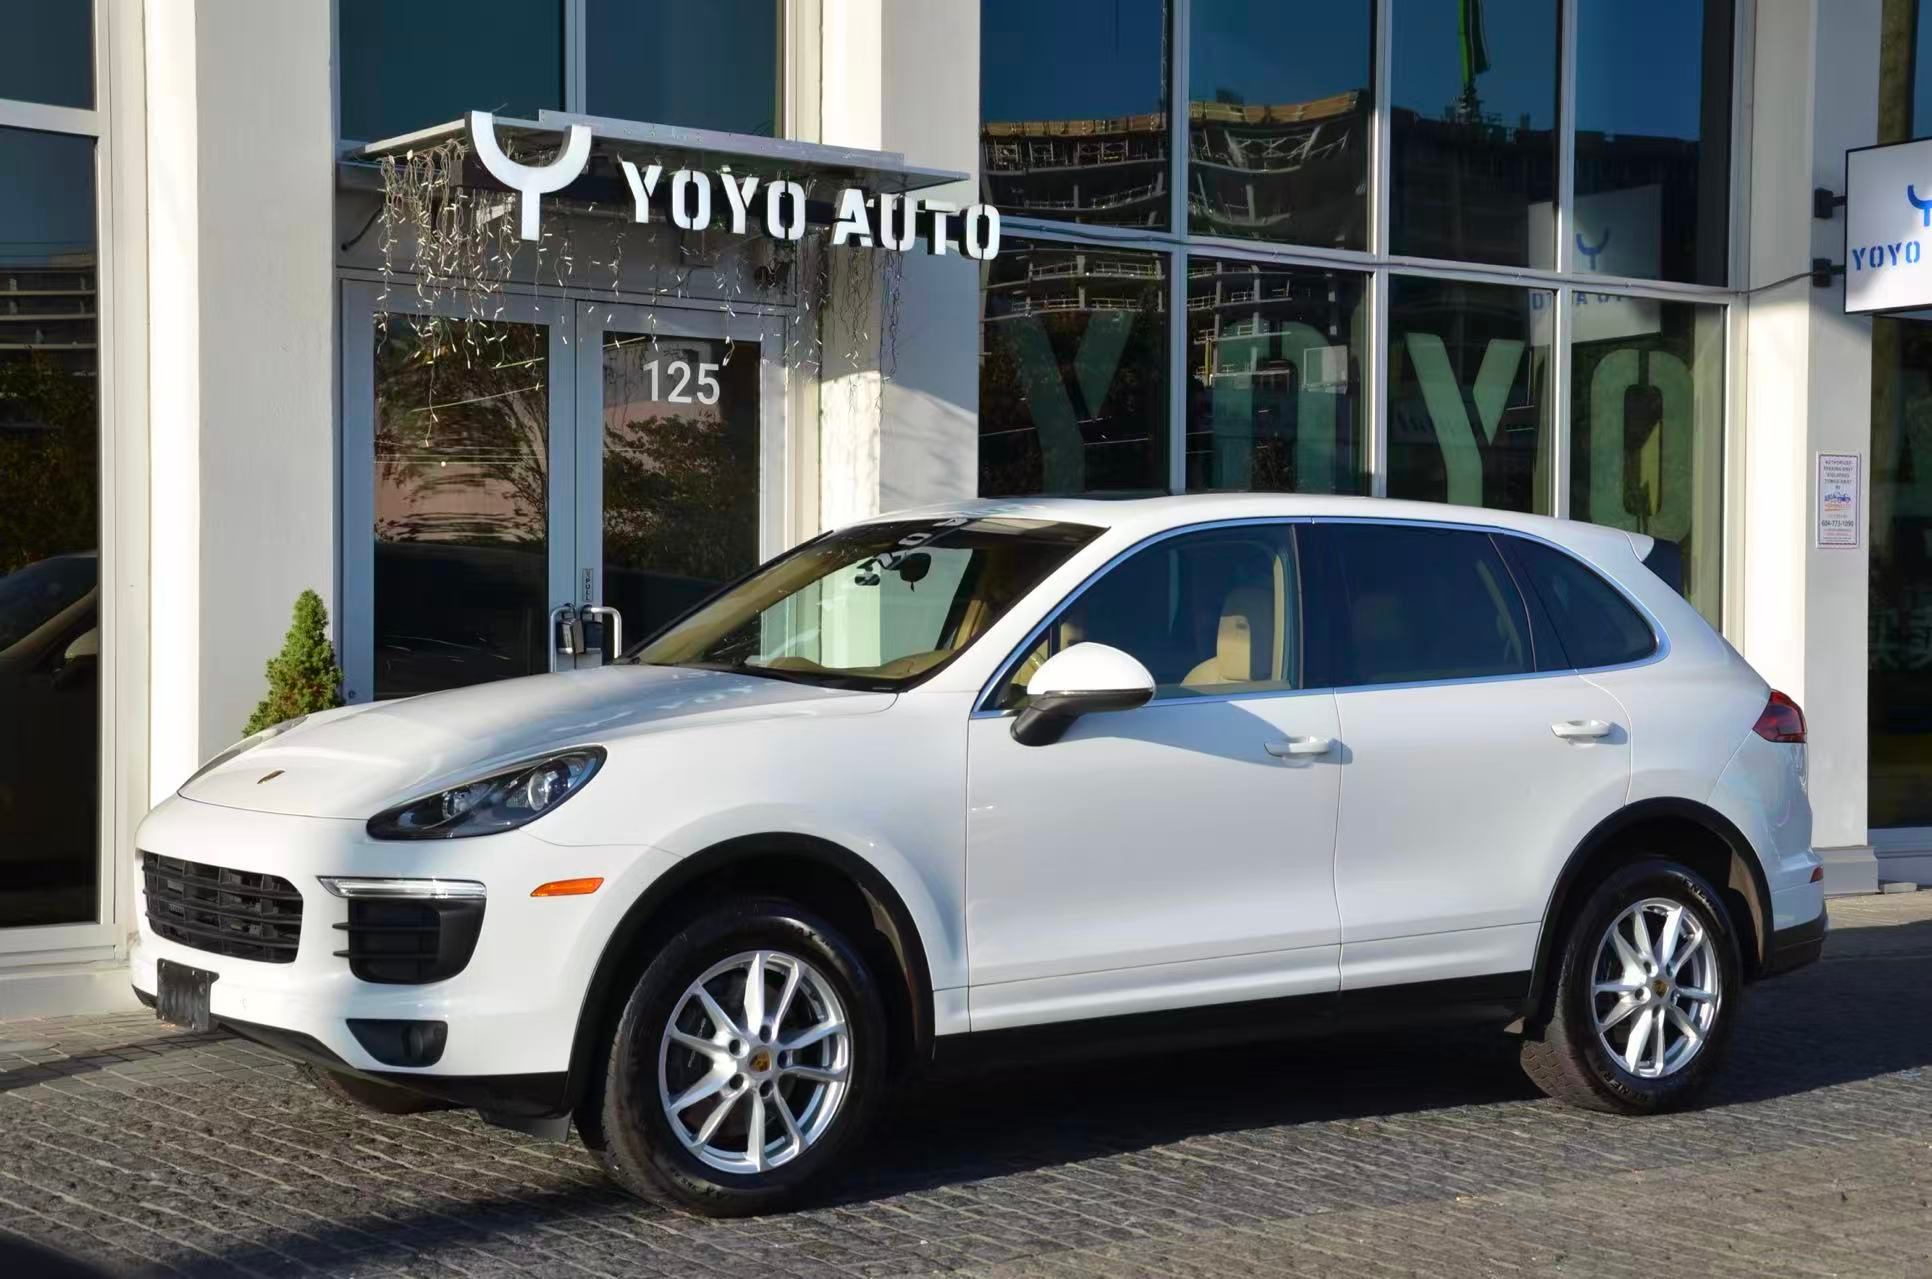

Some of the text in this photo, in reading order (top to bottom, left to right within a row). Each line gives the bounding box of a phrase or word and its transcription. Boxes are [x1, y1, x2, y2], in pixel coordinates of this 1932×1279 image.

[621, 161, 1001, 261] YOYO AUTO
[1852, 240, 1921, 271] YOYO
[643, 360, 720, 405] 125
